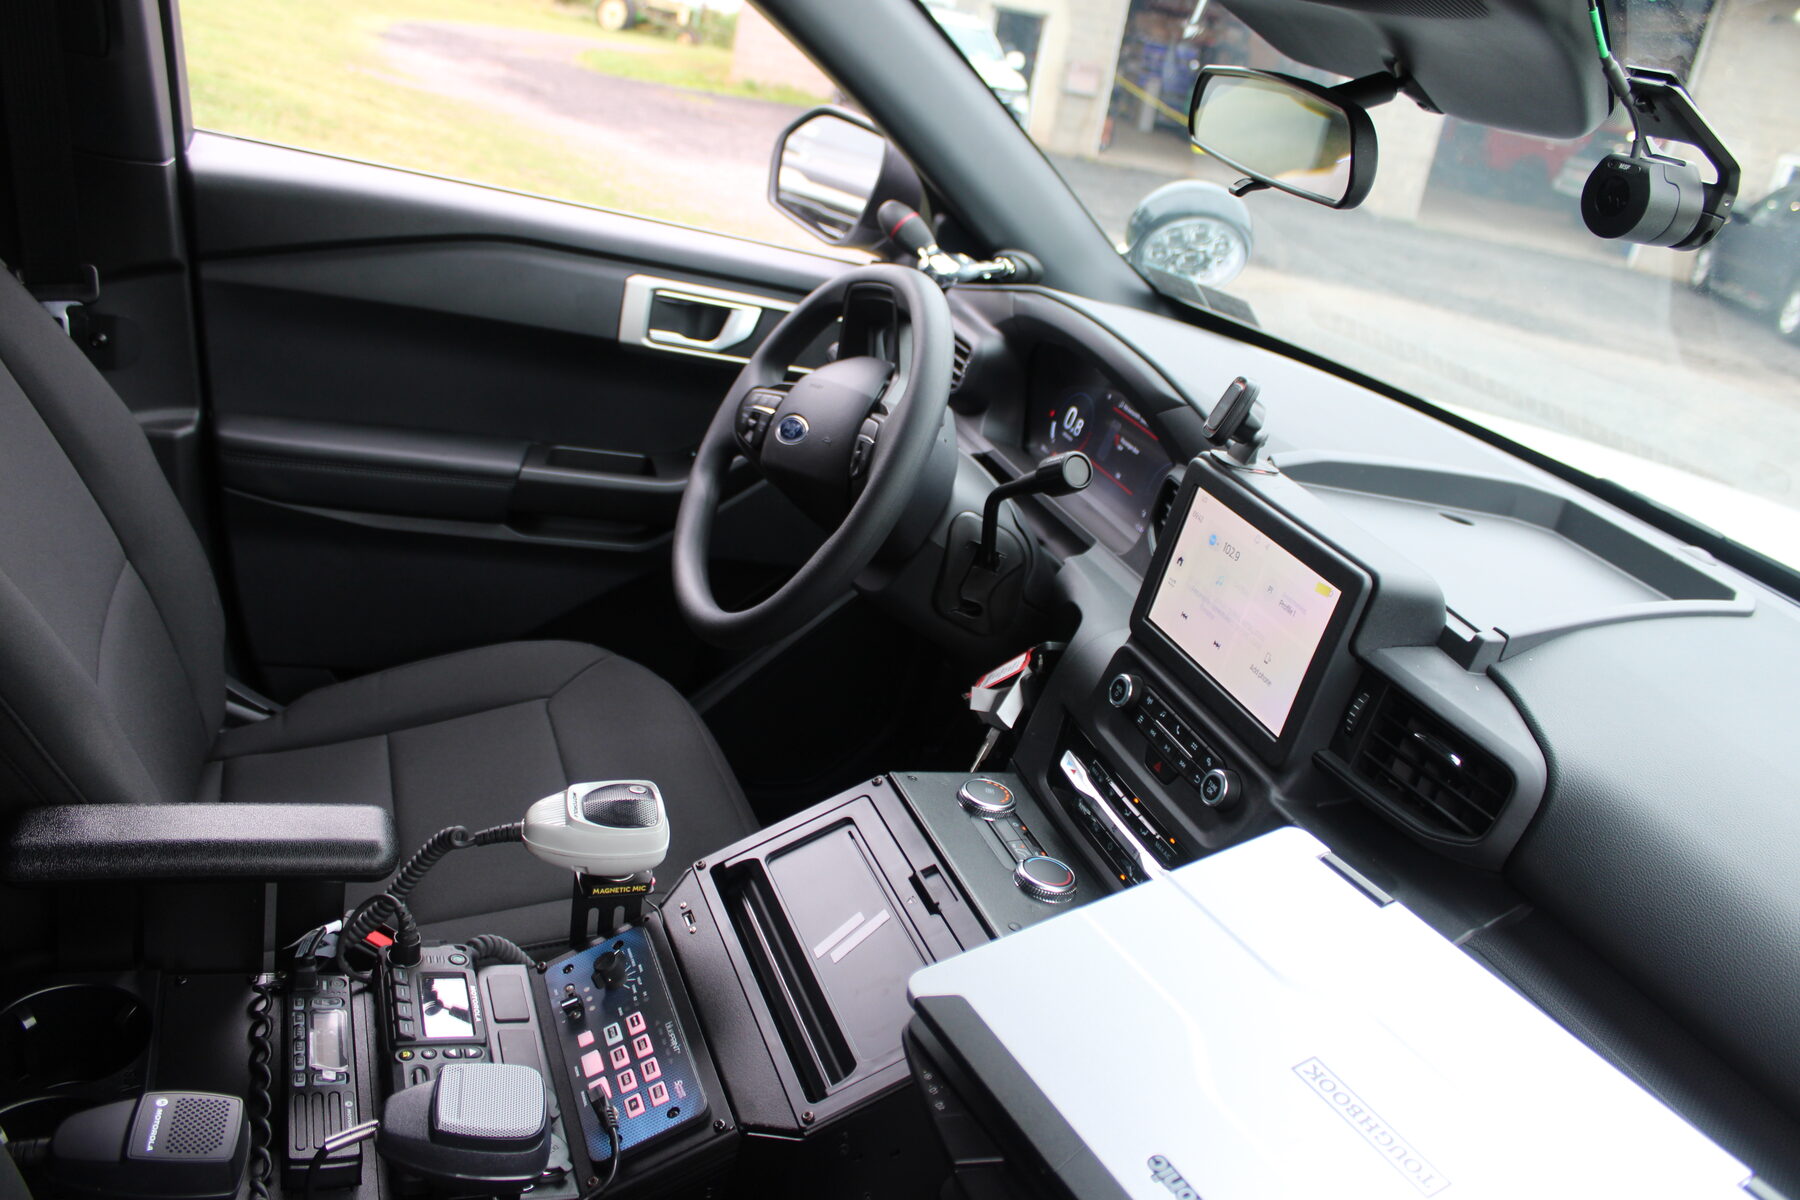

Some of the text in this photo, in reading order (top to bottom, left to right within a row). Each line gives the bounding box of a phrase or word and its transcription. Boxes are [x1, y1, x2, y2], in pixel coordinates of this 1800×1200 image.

[1222, 541, 1241, 562] 102.9
[592, 886, 631, 895] MAGNETIC
[470, 985, 481, 1022] MOTOROLA
[146, 1108, 163, 1152] MOTOROLA
[1302, 1063, 1436, 1189] TOUGHBOOK
